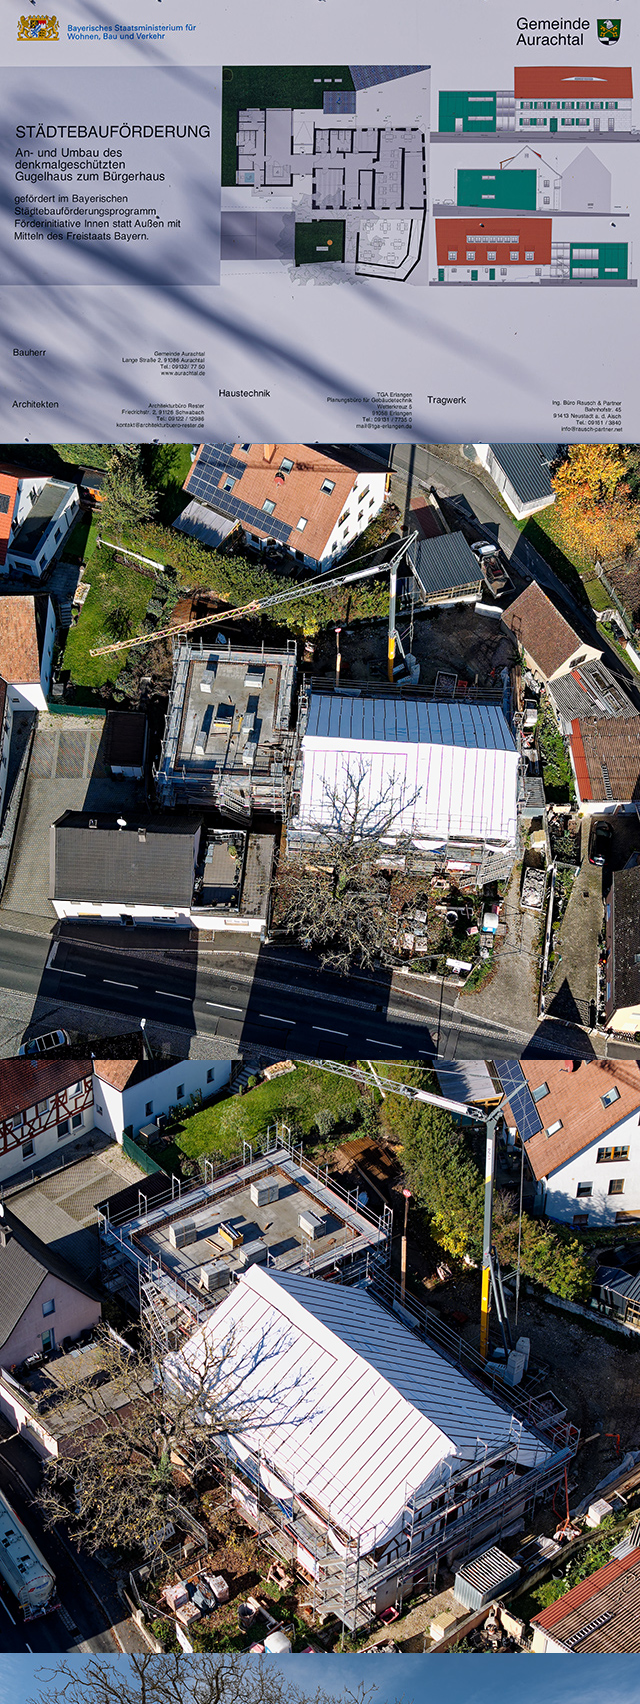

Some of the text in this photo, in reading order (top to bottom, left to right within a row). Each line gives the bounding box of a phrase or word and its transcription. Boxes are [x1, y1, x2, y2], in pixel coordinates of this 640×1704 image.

[517, 17, 590, 30] Gemeinde
[67, 25, 112, 33] Bayerisches
[67, 33, 101, 41] Wohnen,
[515, 33, 584, 46] Aurachtal
[15, 123, 211, 138] STÄDTEBAUFÖRDERUNG
[15, 148, 122, 158] An- und Umbau des
[15, 160, 126, 172] denkmalgeschützten
[15, 171, 165, 183] Gugelhaus zum Bürgerhaus
[14, 194, 128, 205] gefördert im Bayerischen
[15, 218, 181, 228] Förderinitiative Innen statt Außen mit
[14, 232, 149, 242] Mitteln des Freistaats Bayern.
[13, 348, 46, 356] Bauherr
[219, 389, 270, 397] Haustechnik
[12, 400, 59, 408] Architekten
[427, 396, 466, 406] Tragwerk
